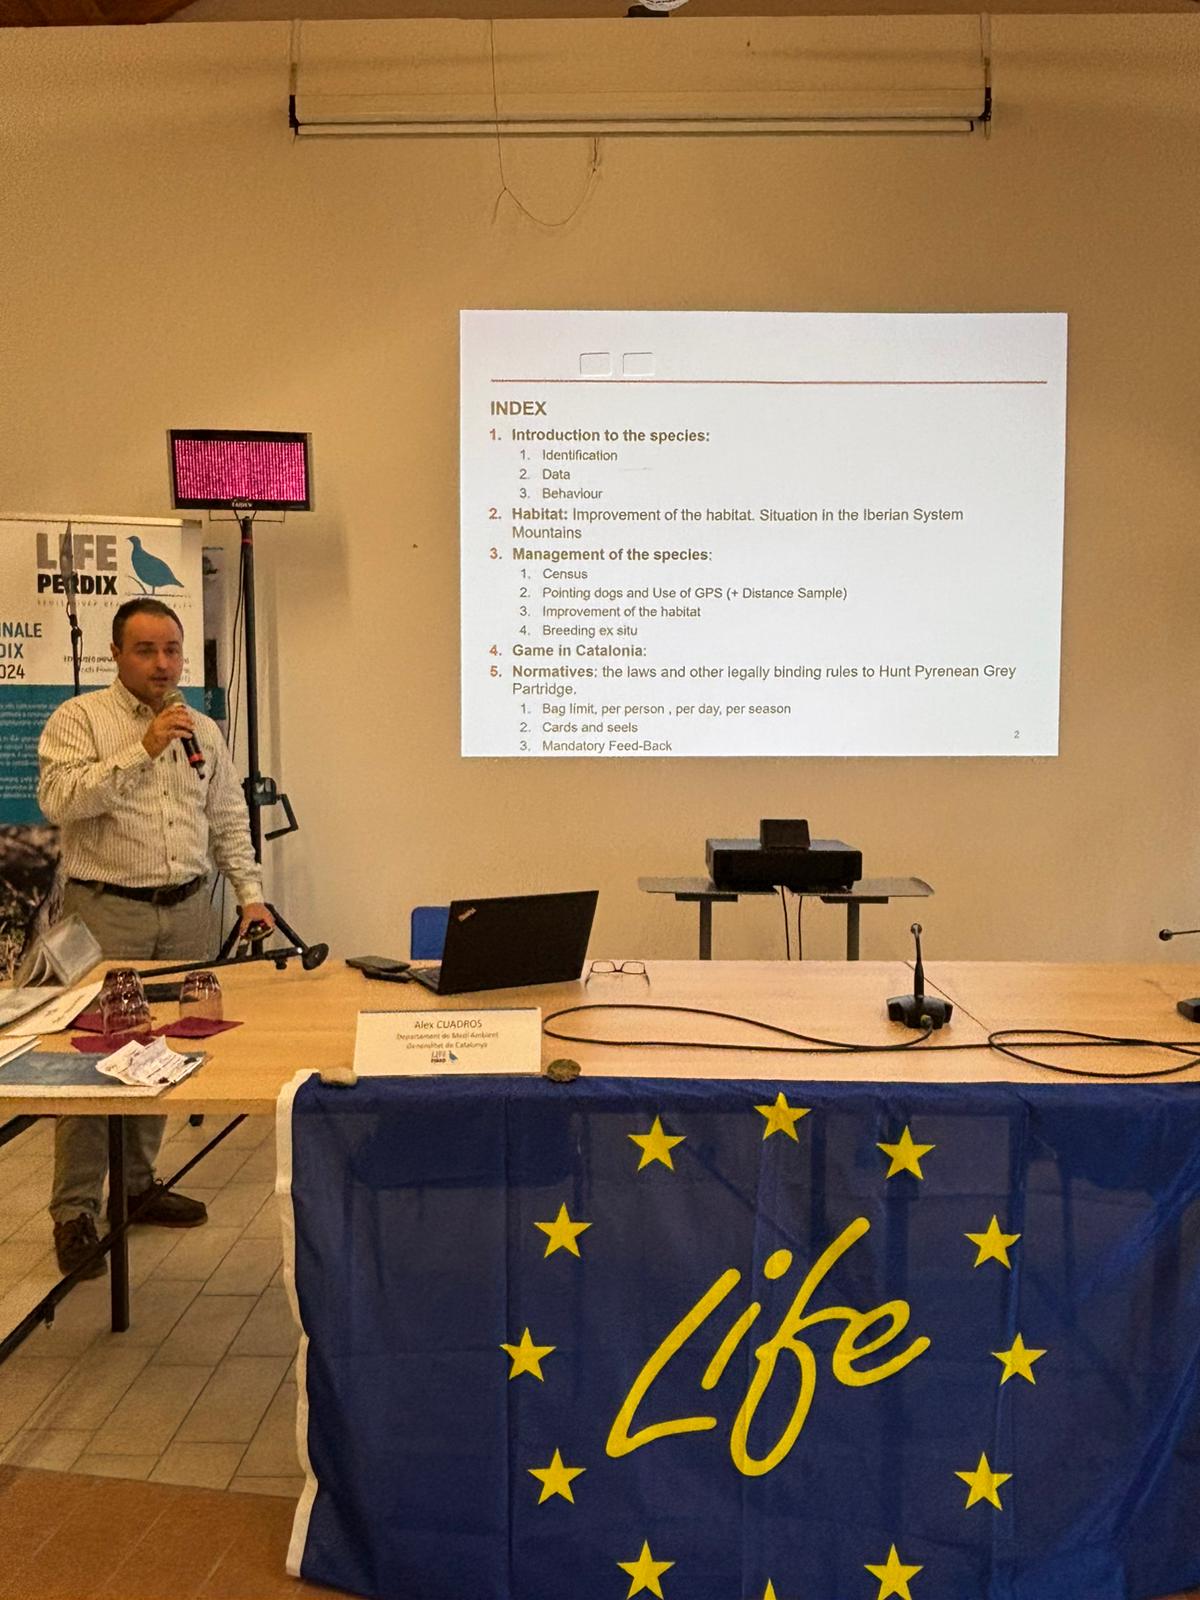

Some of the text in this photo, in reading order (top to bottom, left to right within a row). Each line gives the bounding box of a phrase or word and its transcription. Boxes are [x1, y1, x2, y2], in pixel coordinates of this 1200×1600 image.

[490, 401, 547, 416] INDEX
[489, 428, 709, 445] 1. Introduction to the species:
[519, 449, 617, 461] 1. Identification
[542, 468, 570, 480] Data
[519, 488, 603, 499] 3. Behaviour
[487, 507, 963, 523] 2. Habitat: Improvement of the habitat. Situation in the Iberian System
[511, 526, 582, 539] Mountains
[36, 533, 118, 572] LFE
[489, 547, 712, 563] 3. Management of the species:
[520, 568, 588, 579] 1. Census
[519, 587, 847, 601] 2. Pointing dogs and Use of GPS (+ Distance Sample)
[519, 605, 701, 619] 3. Improvement of the habitat
[518, 625, 637, 639] 4. Breeding ex situ
[488, 644, 646, 657] 4. Game in Catalonia:
[489, 665, 1016, 681] 5. Normatives: the laws and other legally binding rules to Hunt Pyrenean Grey
[512, 682, 576, 698] Partridge.
[520, 703, 531, 714] 1.
[542, 703, 565, 717] Bag
[569, 703, 597, 715] limit,
[601, 706, 621, 717] per
[623, 706, 664, 716] person
[675, 706, 695, 717] per
[697, 703, 722, 717] day,
[725, 706, 745, 716] per
[747, 706, 791, 714] season
[519, 722, 638, 733] 2. Cards and seels
[1013, 730, 1019, 739] 2
[519, 740, 672, 753] 3. Mandatory Feed-Back
[414, 1019, 483, 1029] Alex CUADROS
[606, 1217, 931, 1477] Life
